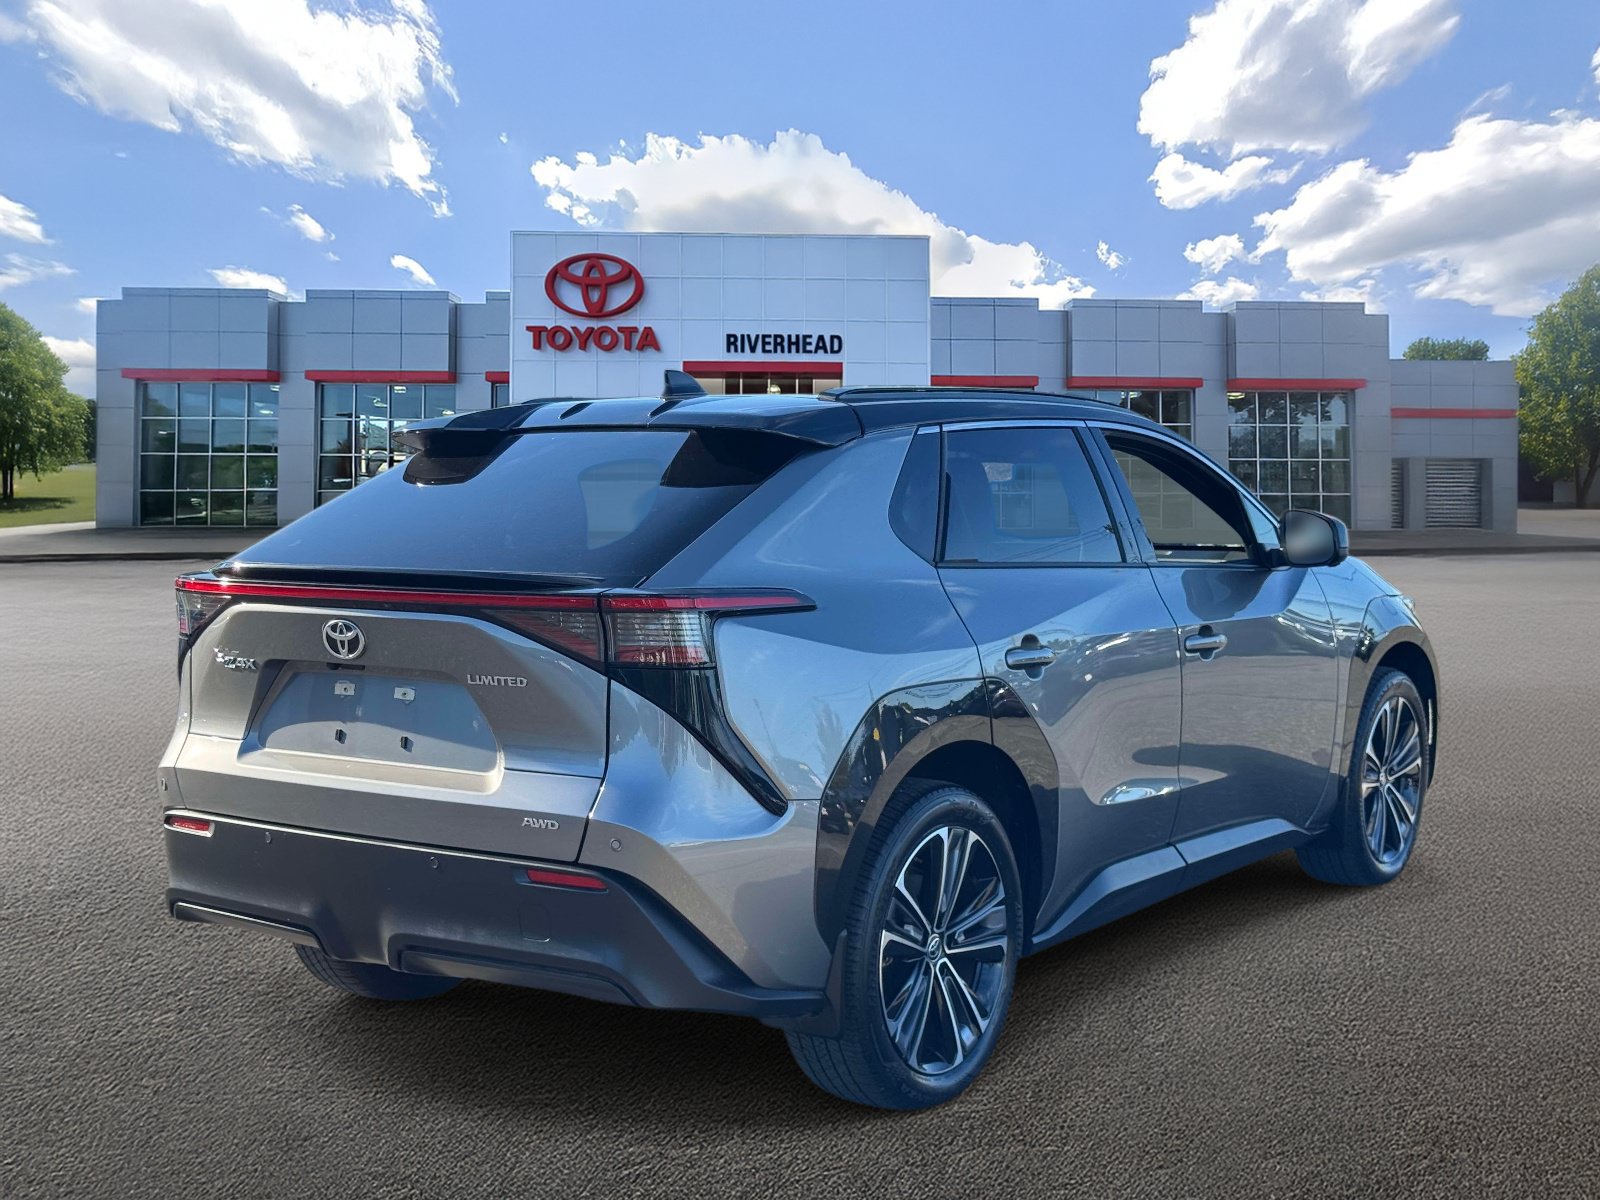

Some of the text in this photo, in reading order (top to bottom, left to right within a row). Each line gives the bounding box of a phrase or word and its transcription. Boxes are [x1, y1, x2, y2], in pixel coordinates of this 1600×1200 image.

[526, 325, 661, 352] TOYOTA
[726, 333, 843, 354] RIVERHEAD
[466, 674, 528, 687] LIMITED
[521, 817, 559, 830] AWD
